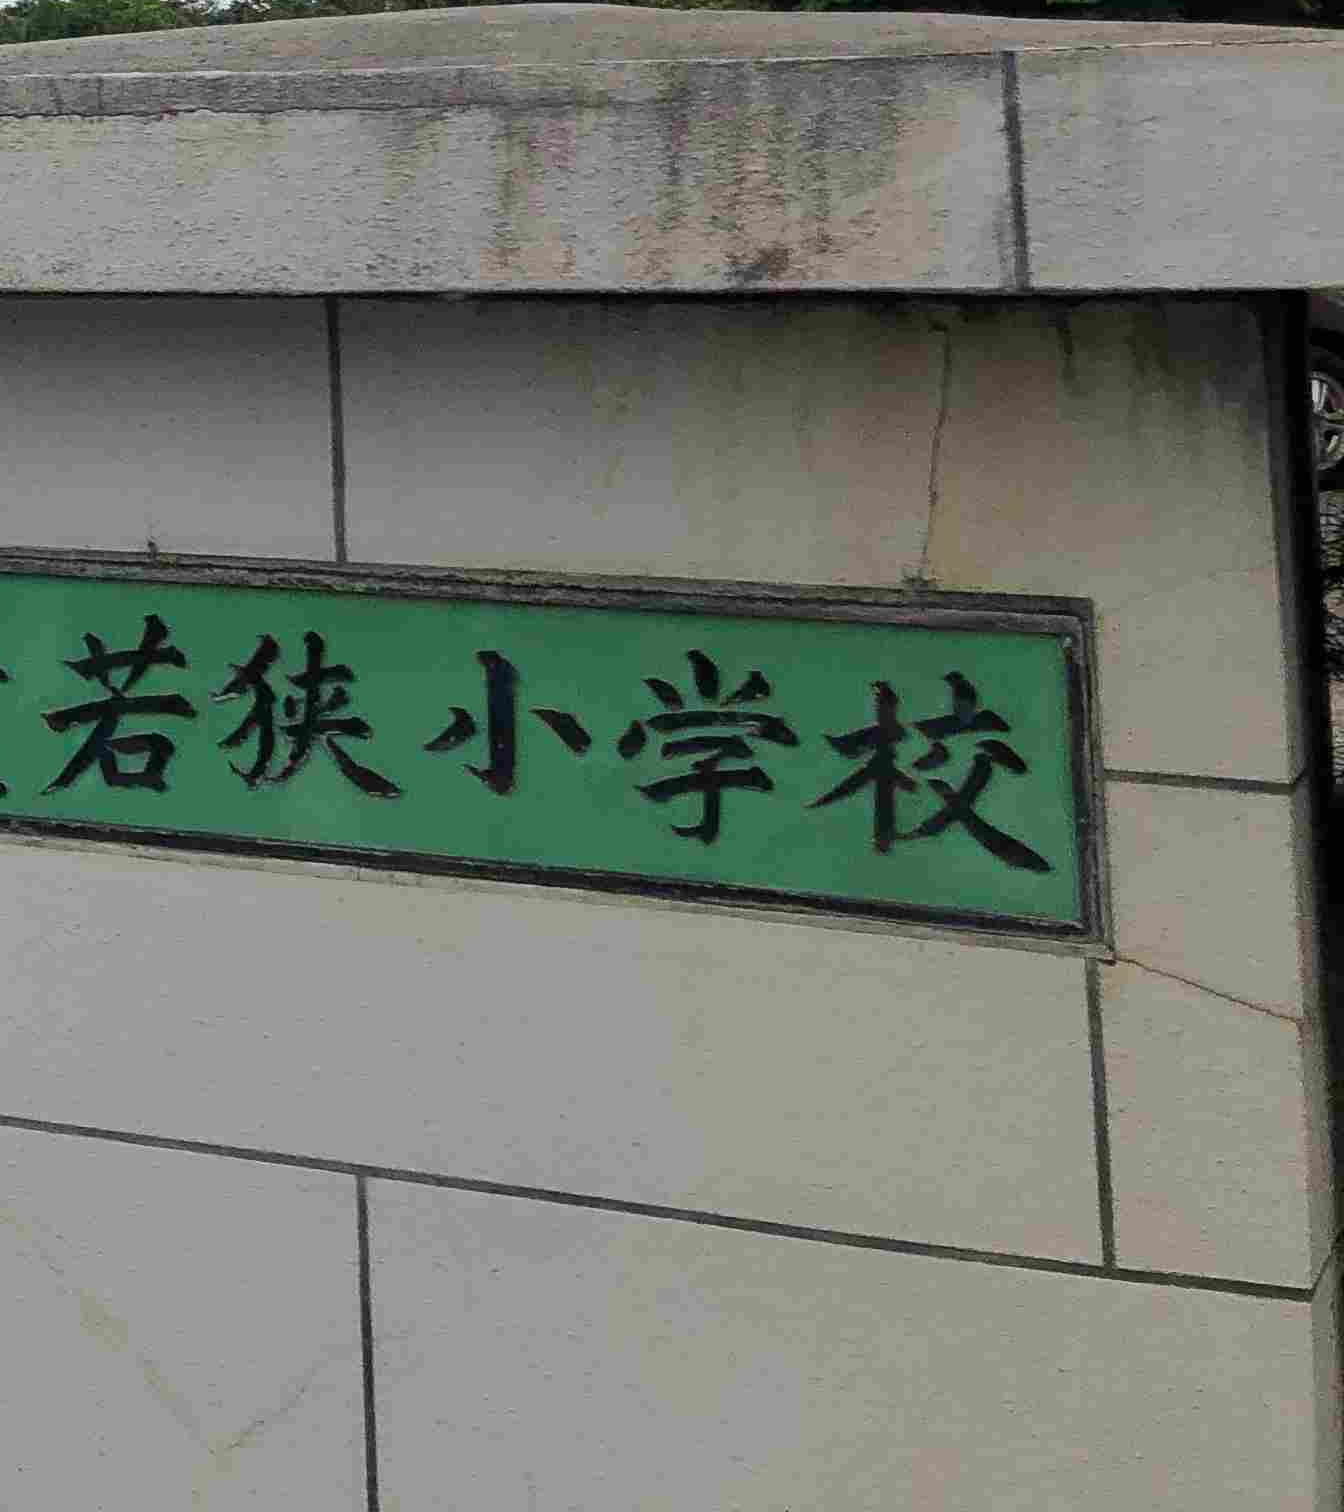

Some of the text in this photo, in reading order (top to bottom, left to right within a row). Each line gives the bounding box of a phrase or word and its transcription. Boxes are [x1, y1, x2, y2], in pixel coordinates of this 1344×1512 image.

[40, 615, 1053, 874] 若狭小学校
